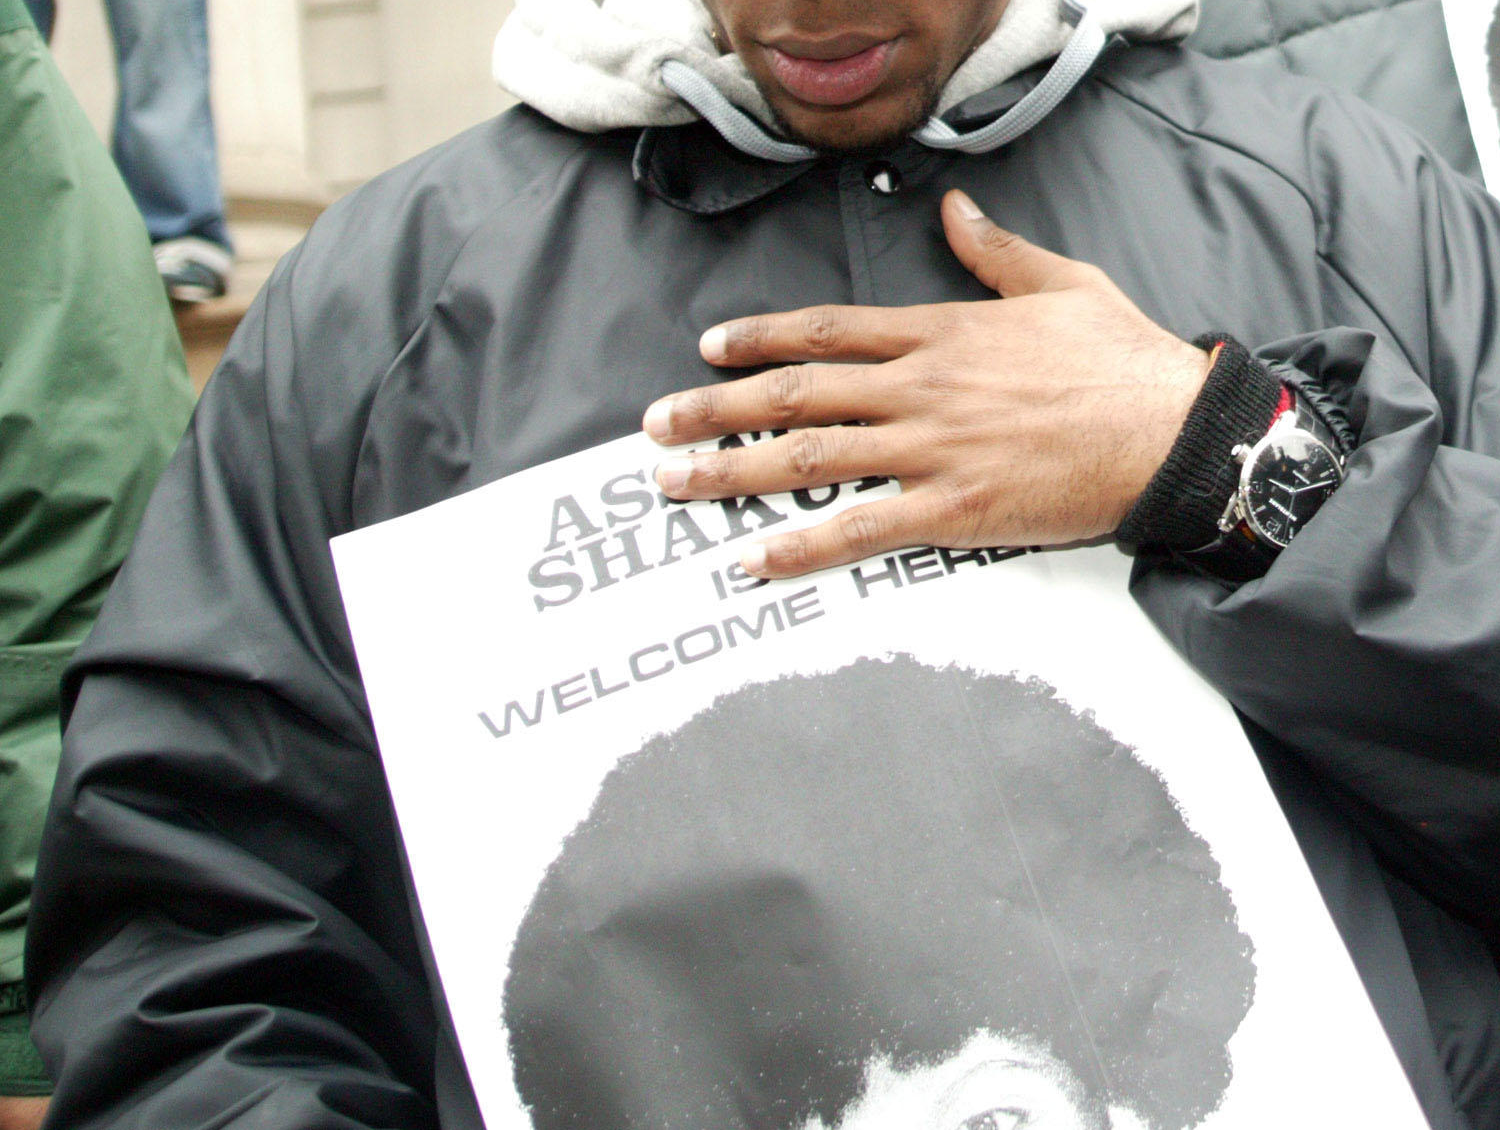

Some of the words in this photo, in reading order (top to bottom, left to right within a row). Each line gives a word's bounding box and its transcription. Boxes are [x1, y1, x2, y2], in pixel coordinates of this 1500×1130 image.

[528, 476, 889, 613] SHAK
[477, 585, 825, 738] WELCOME
[851, 545, 1043, 599] HER
